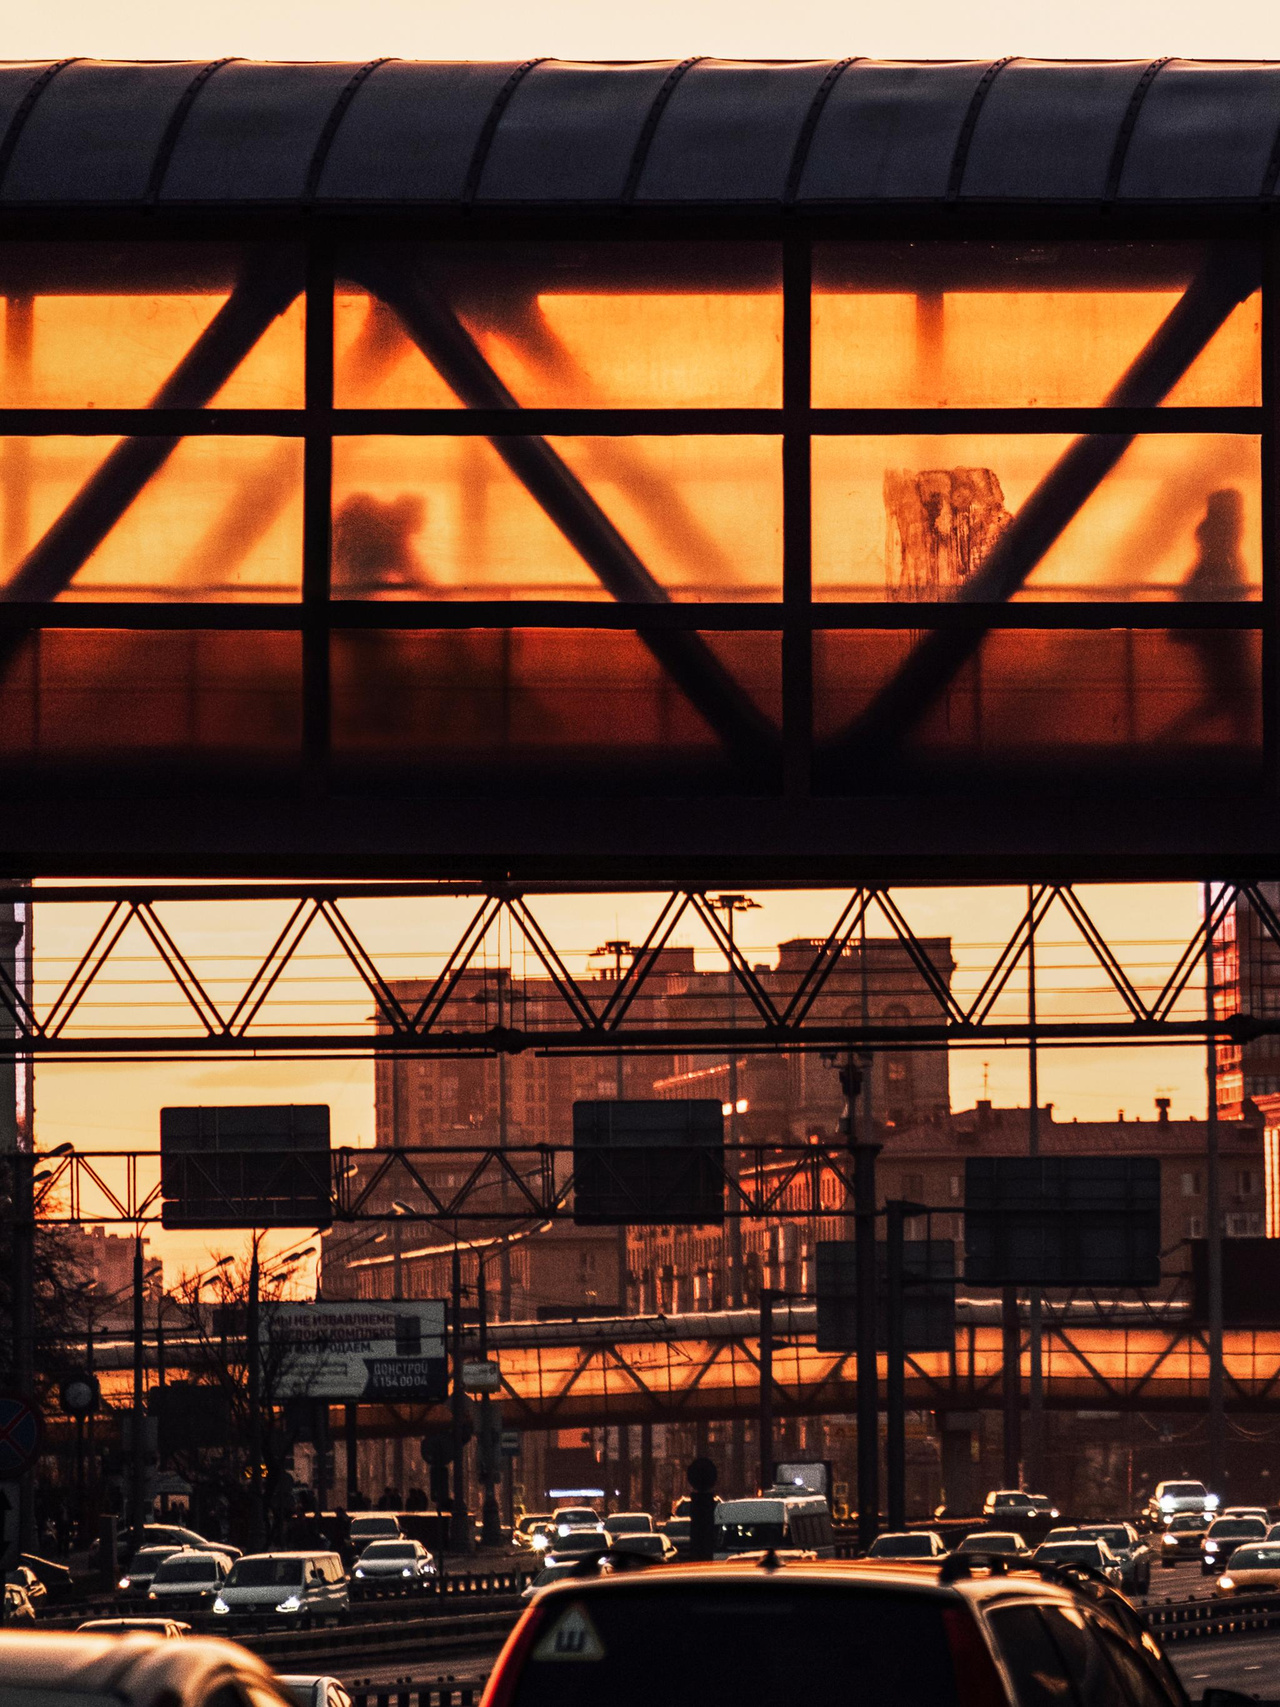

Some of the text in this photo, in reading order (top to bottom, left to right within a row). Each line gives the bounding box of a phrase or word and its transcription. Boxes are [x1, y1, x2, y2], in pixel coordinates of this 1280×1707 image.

[294, 1315, 311, 1326] НЕ
[312, 1313, 395, 1326] ИЗБАВЛЯЕМС
[373, 1361, 428, 1375] ДОНСТРОЙ
[555, 1630, 585, 1652] Ш
